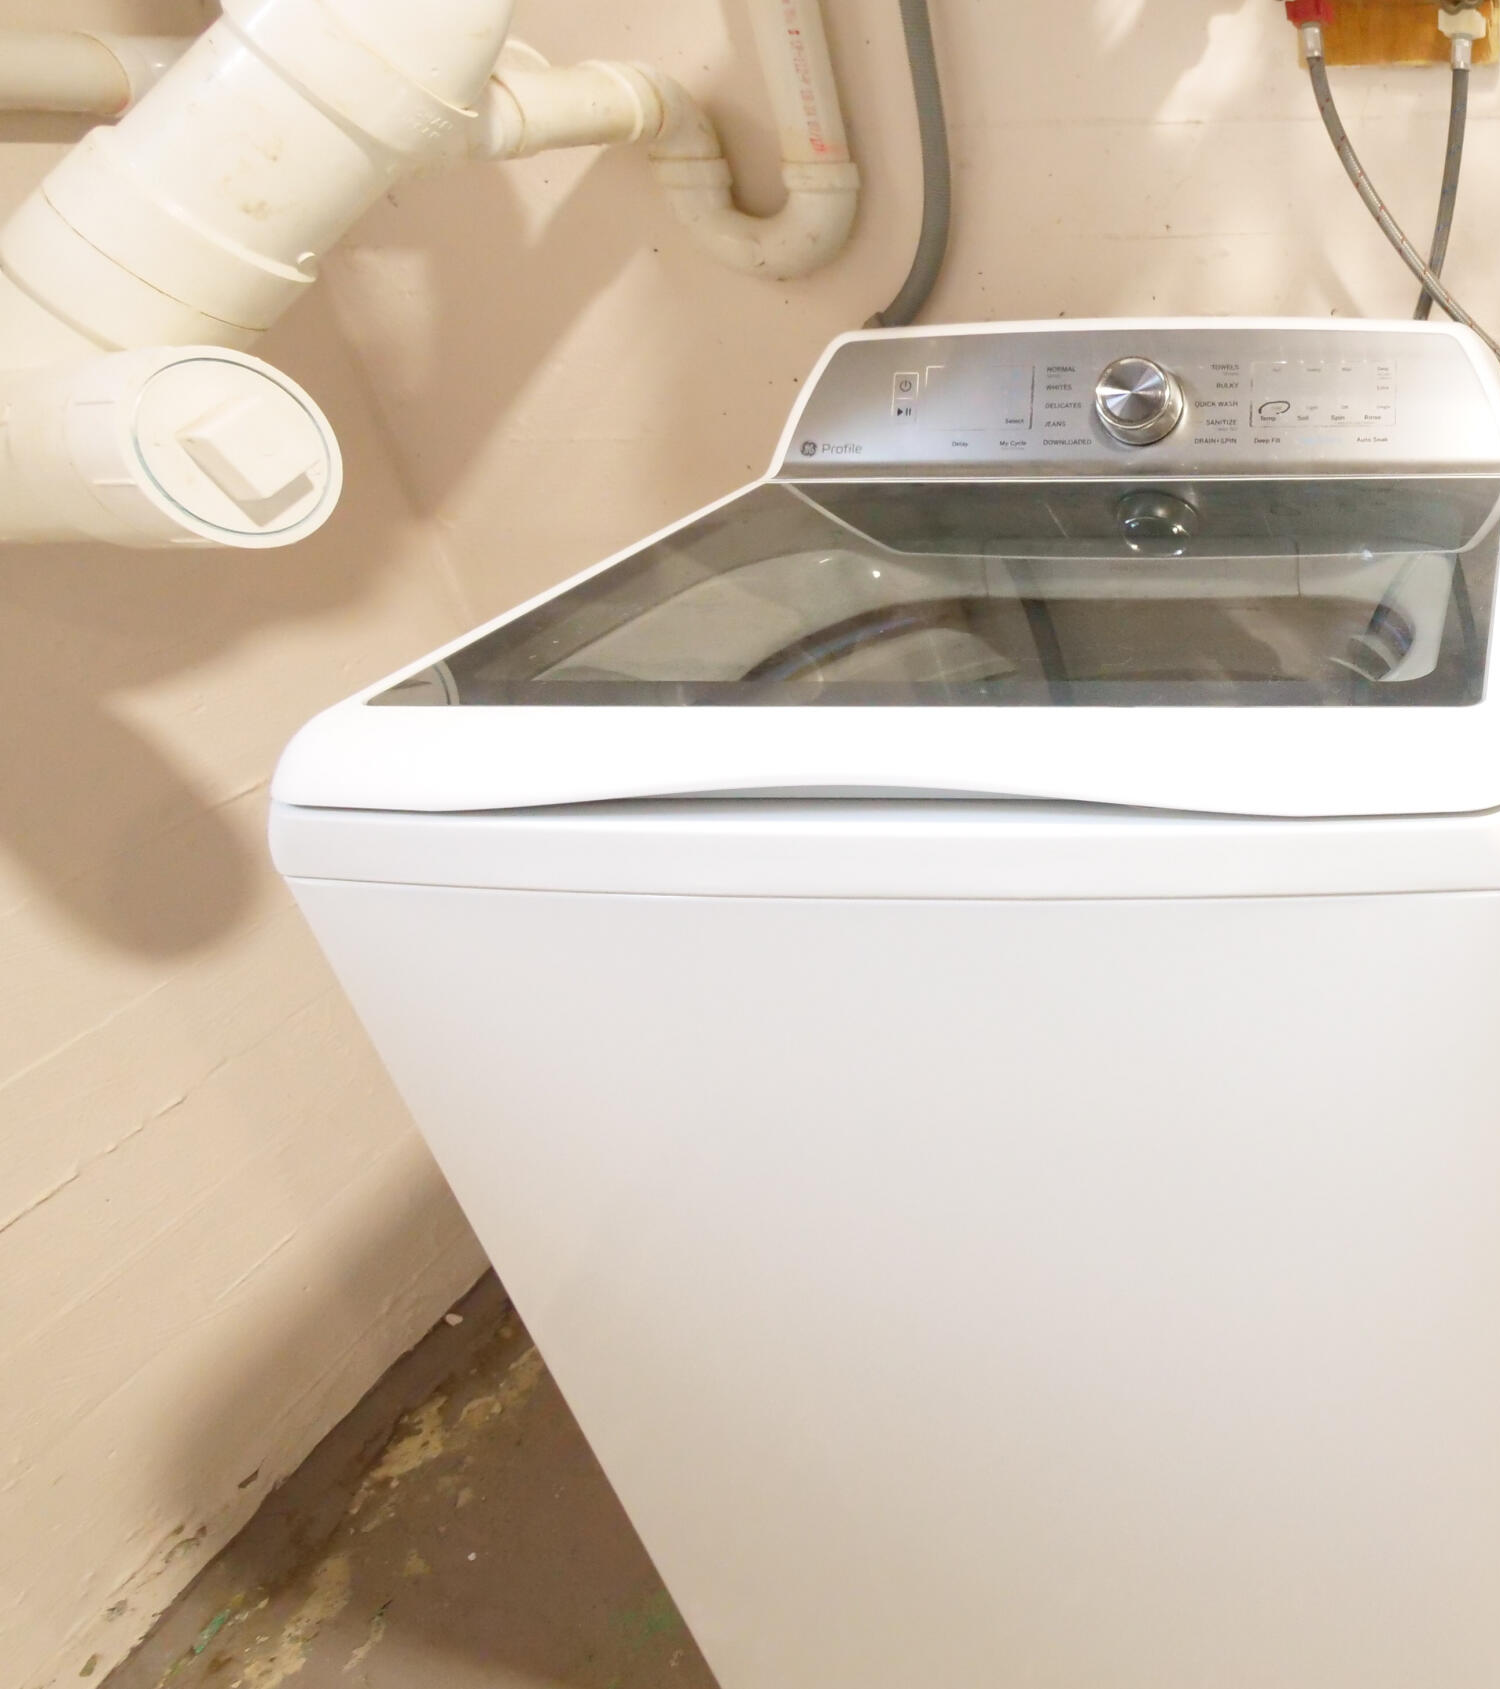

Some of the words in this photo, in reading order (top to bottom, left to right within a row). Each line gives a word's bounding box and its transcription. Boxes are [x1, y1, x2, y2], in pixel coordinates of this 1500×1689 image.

[1044, 420, 1067, 428] JEANS
[999, 440, 1009, 448] My
[1010, 440, 1027, 448] Cycle
[1253, 437, 1270, 445] Deep
[821, 443, 863, 455] Profile
